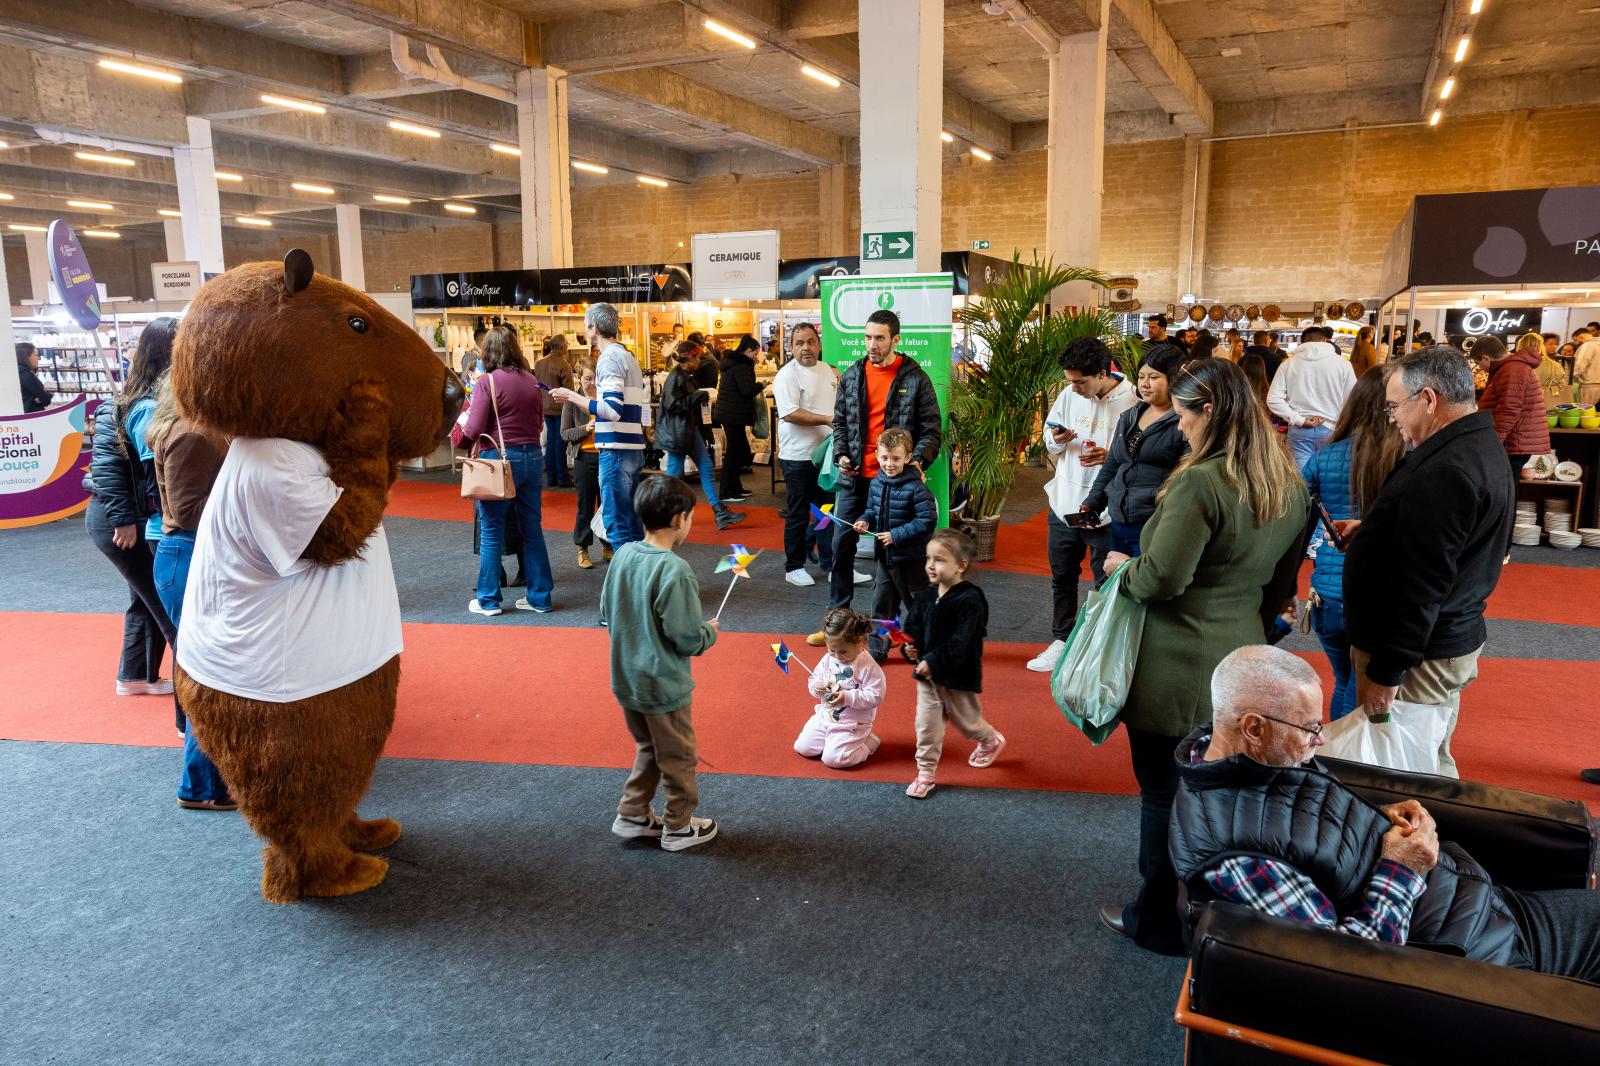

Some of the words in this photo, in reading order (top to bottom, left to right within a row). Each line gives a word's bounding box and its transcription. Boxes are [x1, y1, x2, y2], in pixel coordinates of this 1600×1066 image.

[709, 252, 761, 262] CERAMIQUE
[841, 338, 859, 346] Você
[904, 338, 929, 346] fatura
[851, 348, 861, 356] de
[919, 359, 932, 367] até
[0, 432, 34, 449] pital
